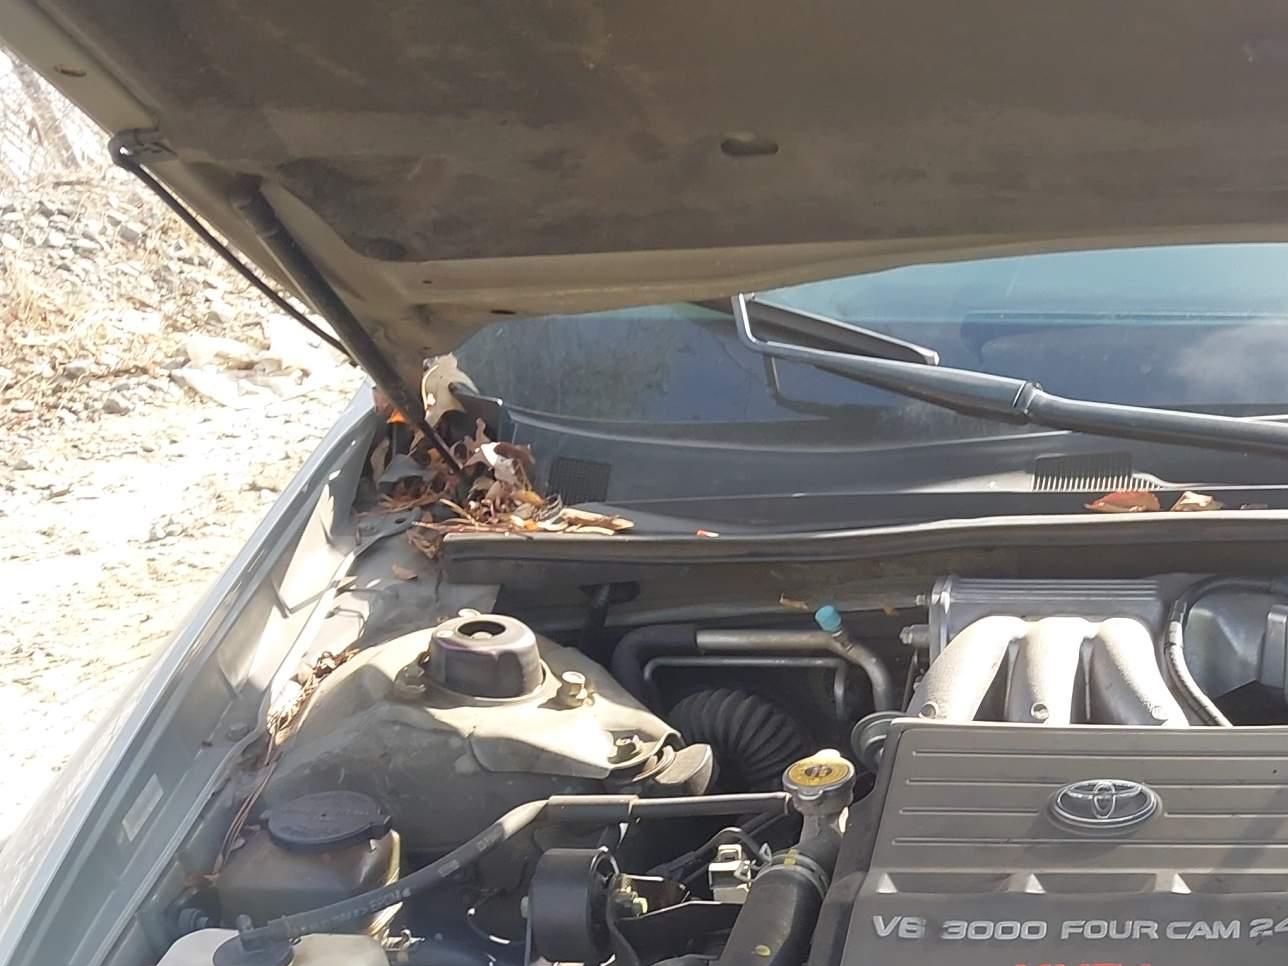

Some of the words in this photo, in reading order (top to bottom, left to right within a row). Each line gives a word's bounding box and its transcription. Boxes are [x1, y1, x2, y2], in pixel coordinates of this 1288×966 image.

[872, 915, 926, 939] V6
[941, 920, 1048, 940] 3000
[1060, 920, 1159, 940] FOUR
[1166, 920, 1240, 940] CAM
